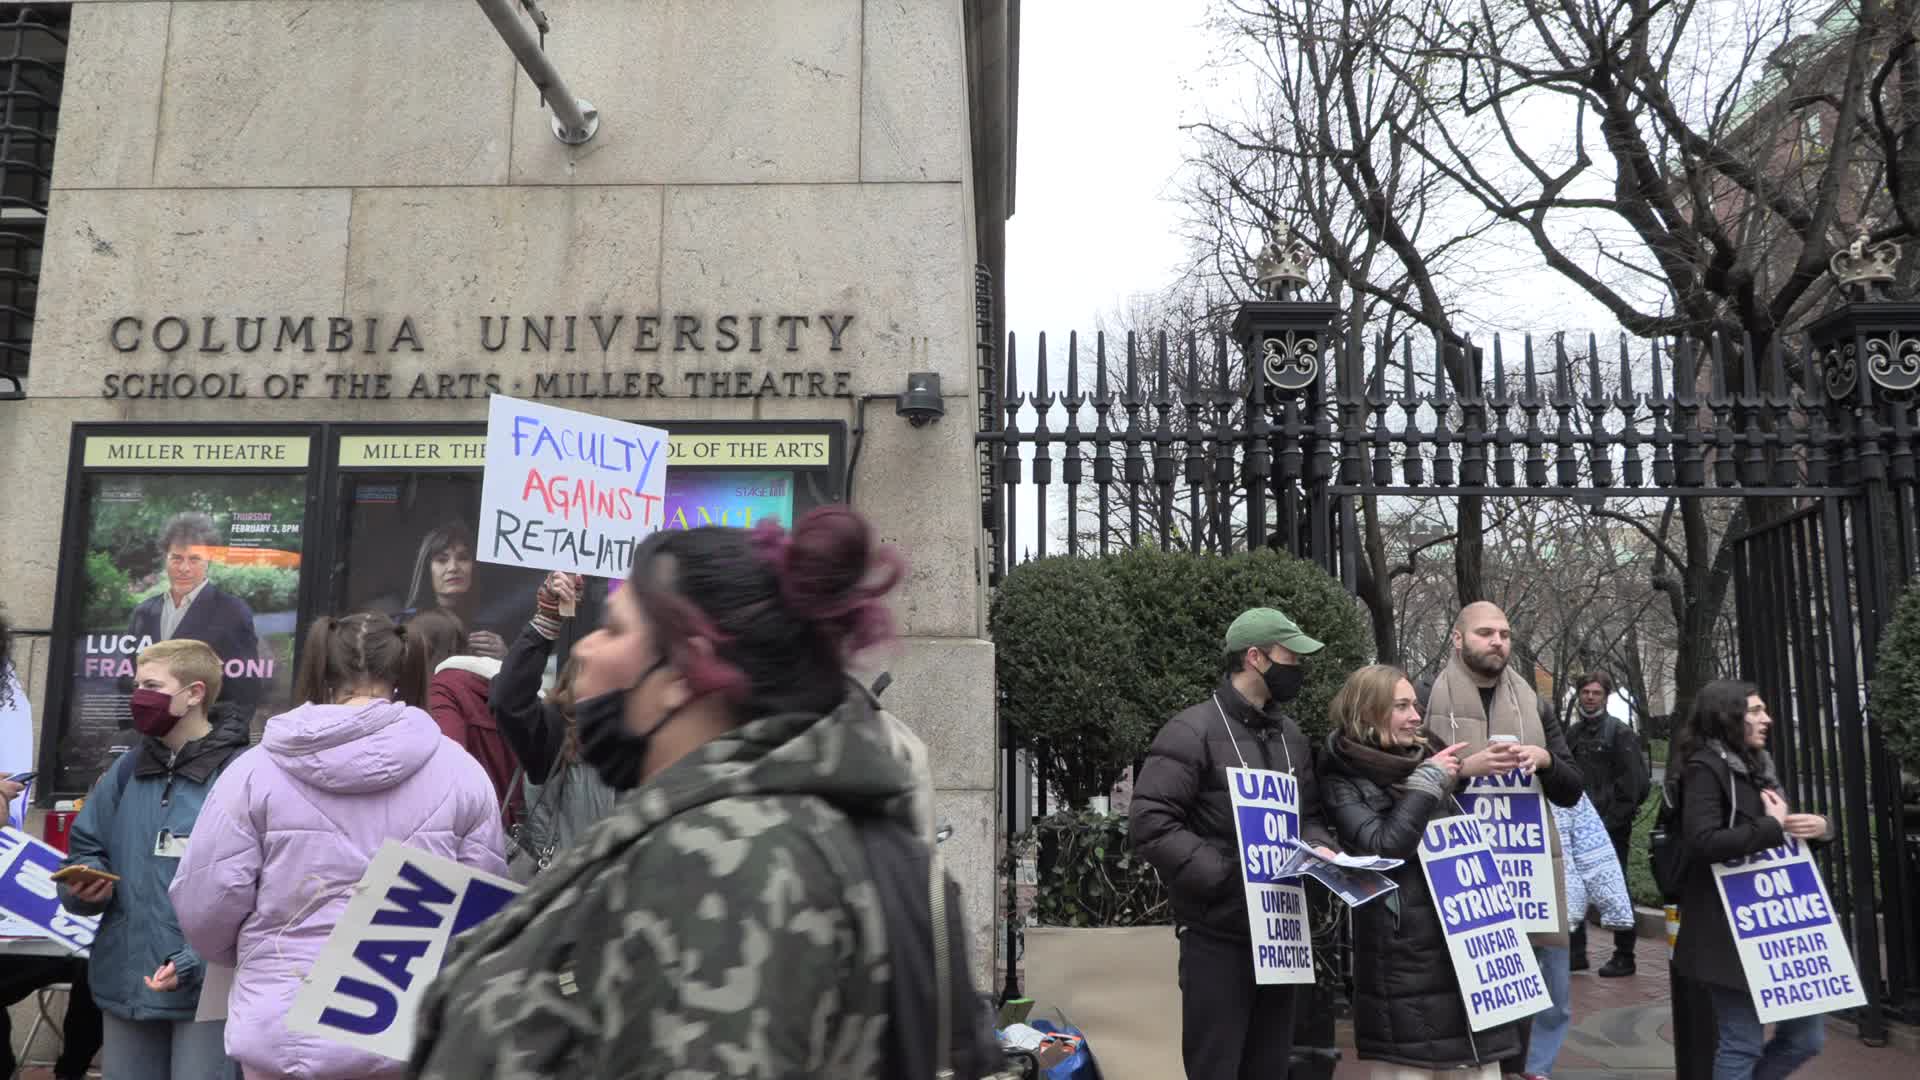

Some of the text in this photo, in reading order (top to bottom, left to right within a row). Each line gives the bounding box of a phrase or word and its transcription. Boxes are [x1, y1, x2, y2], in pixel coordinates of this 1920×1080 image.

[109, 315, 855, 353] COLUMBIA UNIVERSITY
[102, 371, 853, 399] SCHOOL OF THE ARTS MILLER THEATRE
[107, 444, 286, 460] MILLER THEATRE
[363, 444, 440, 460] MILLER
[512, 415, 660, 496] FACULTY
[693, 443, 720, 458] OF
[727, 443, 767, 458] THE
[775, 443, 824, 458] ARTS
[522, 467, 662, 529] AGAINST
[231, 523, 271, 533] FEBRUARY
[493, 509, 657, 572] RETALIATI
[86, 634, 154, 655] LUCA
[1237, 772, 1295, 806] UAW
[1474, 796, 1511, 821] ON
[1264, 811, 1288, 844] ON
[1422, 819, 1483, 853] UAW
[1455, 855, 1487, 888] ON
[1754, 868, 1793, 898] ON
[1261, 889, 1301, 915] UNFAIR
[1443, 884, 1513, 926] STRIKE
[1736, 892, 1828, 932] STRIKE
[1266, 918, 1302, 941] LABOR
[1464, 927, 1519, 959] UNFAIR
[318, 860, 459, 1036] UAW
[1258, 944, 1311, 969] PRACTICE
[1758, 932, 1828, 961] UNFAIR
[1475, 952, 1526, 985] LABOR
[1768, 955, 1832, 983] LABOR
[1470, 974, 1543, 1016] PRACTICE
[1760, 974, 1854, 1009] PRACTICE
